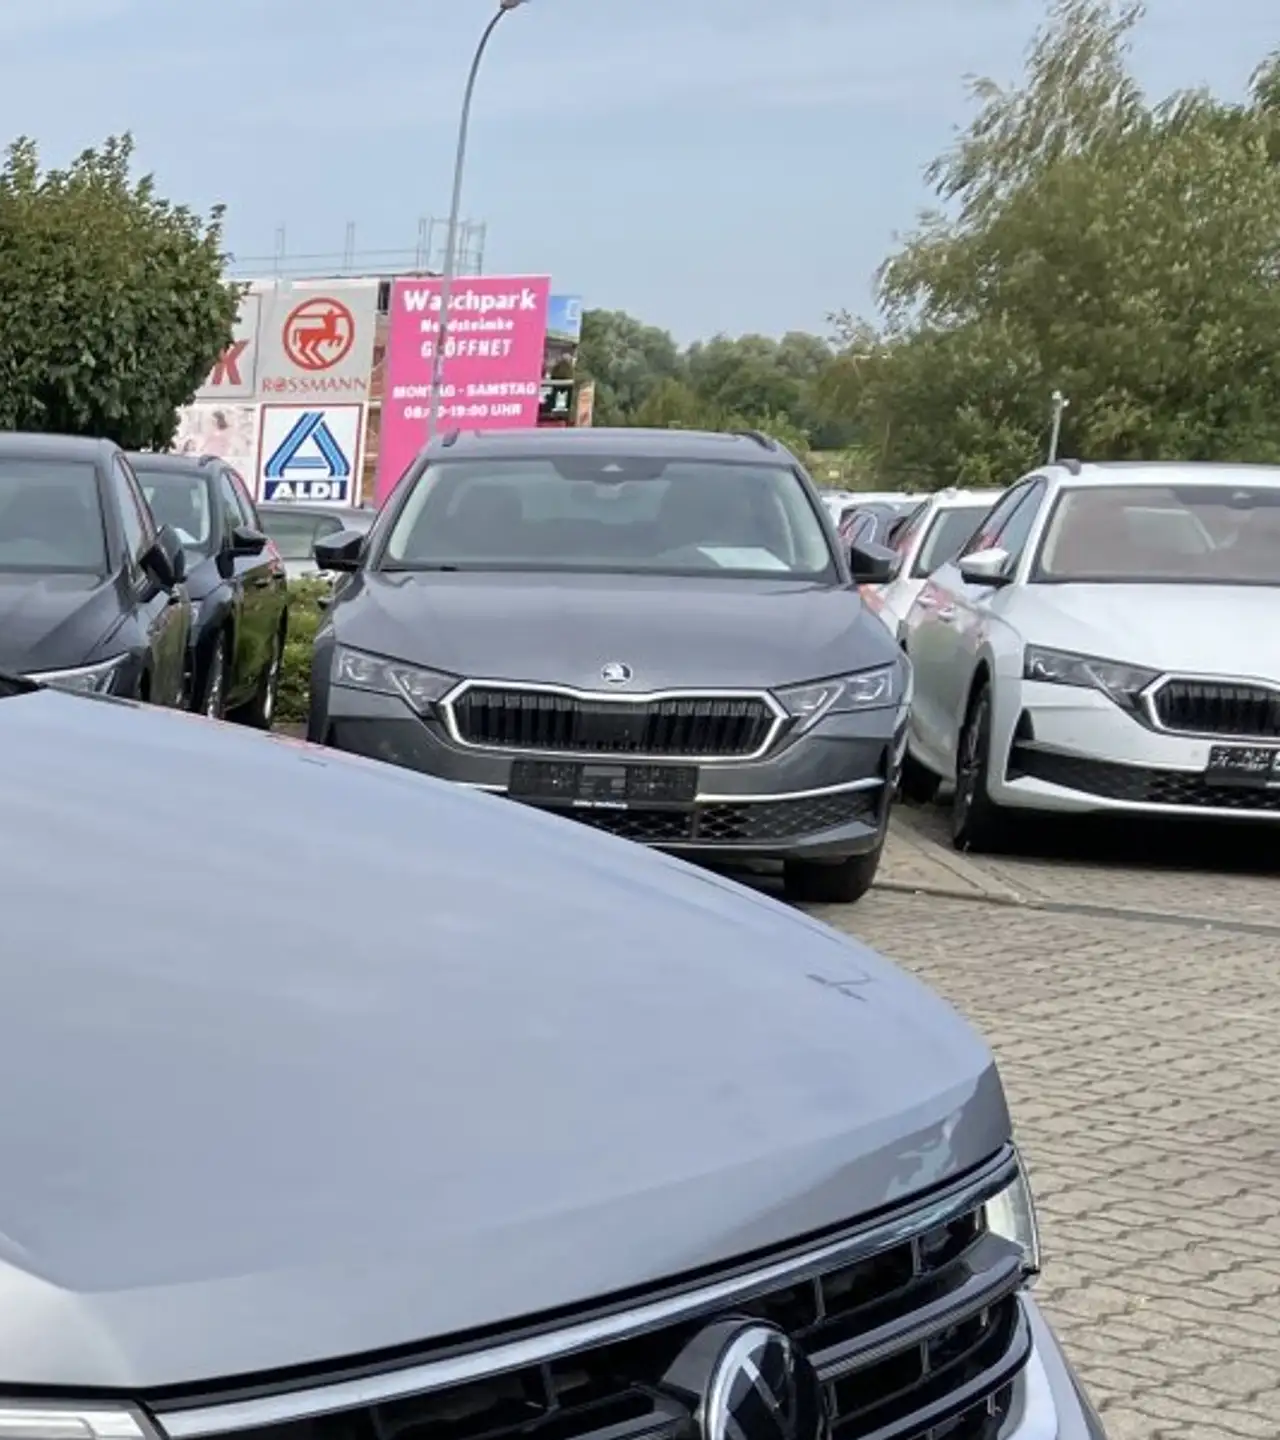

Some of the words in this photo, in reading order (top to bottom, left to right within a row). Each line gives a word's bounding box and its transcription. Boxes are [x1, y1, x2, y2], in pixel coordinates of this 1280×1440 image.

[420, 337, 513, 359] GÖFFNET
[261, 376, 367, 393] ROSSMANN
[466, 381, 537, 398] SAMSTAG
[490, 402, 523, 417] UHR
[271, 481, 341, 500] ALDI
